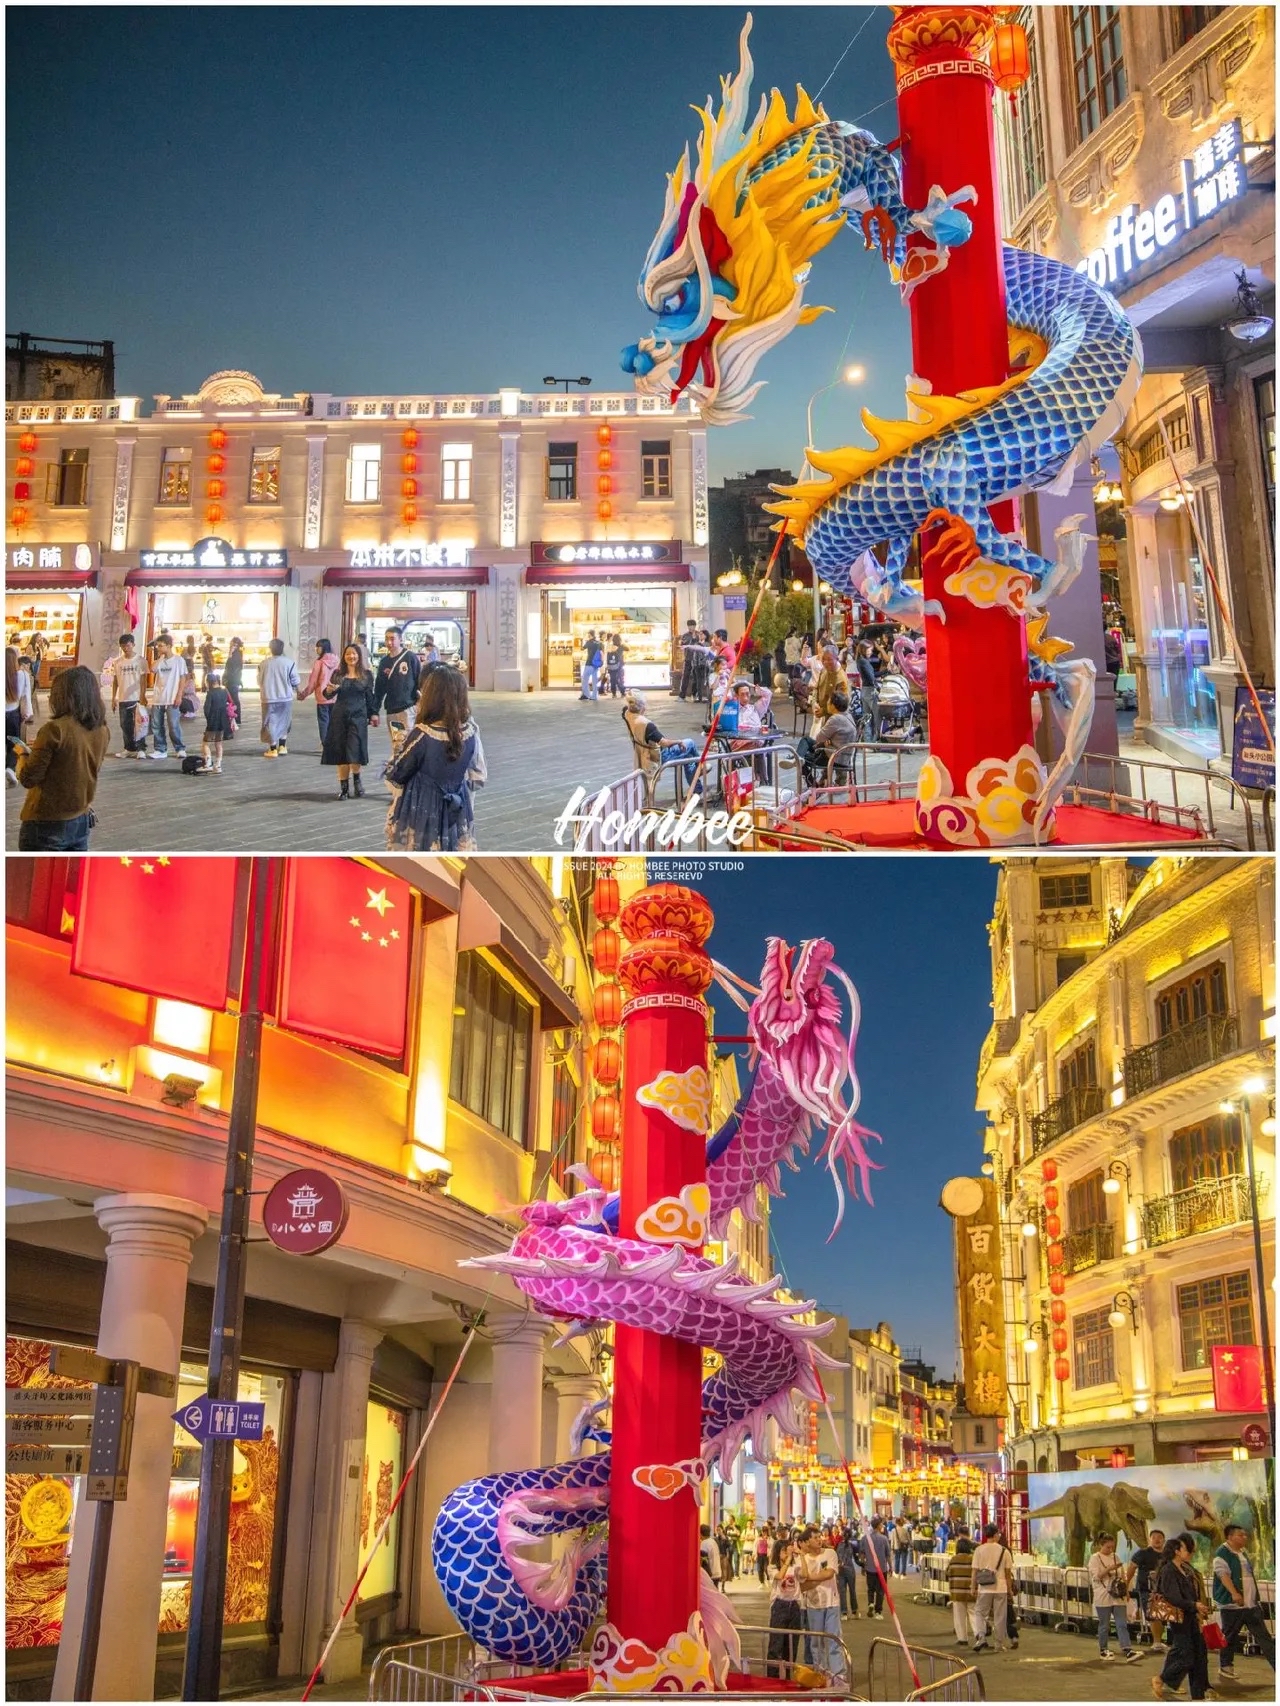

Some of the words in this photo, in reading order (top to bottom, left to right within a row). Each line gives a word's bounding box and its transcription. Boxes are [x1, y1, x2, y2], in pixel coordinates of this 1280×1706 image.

[11, 1419, 75, 1432] 游客服务中心
[240, 1421, 260, 1429] TOILET
